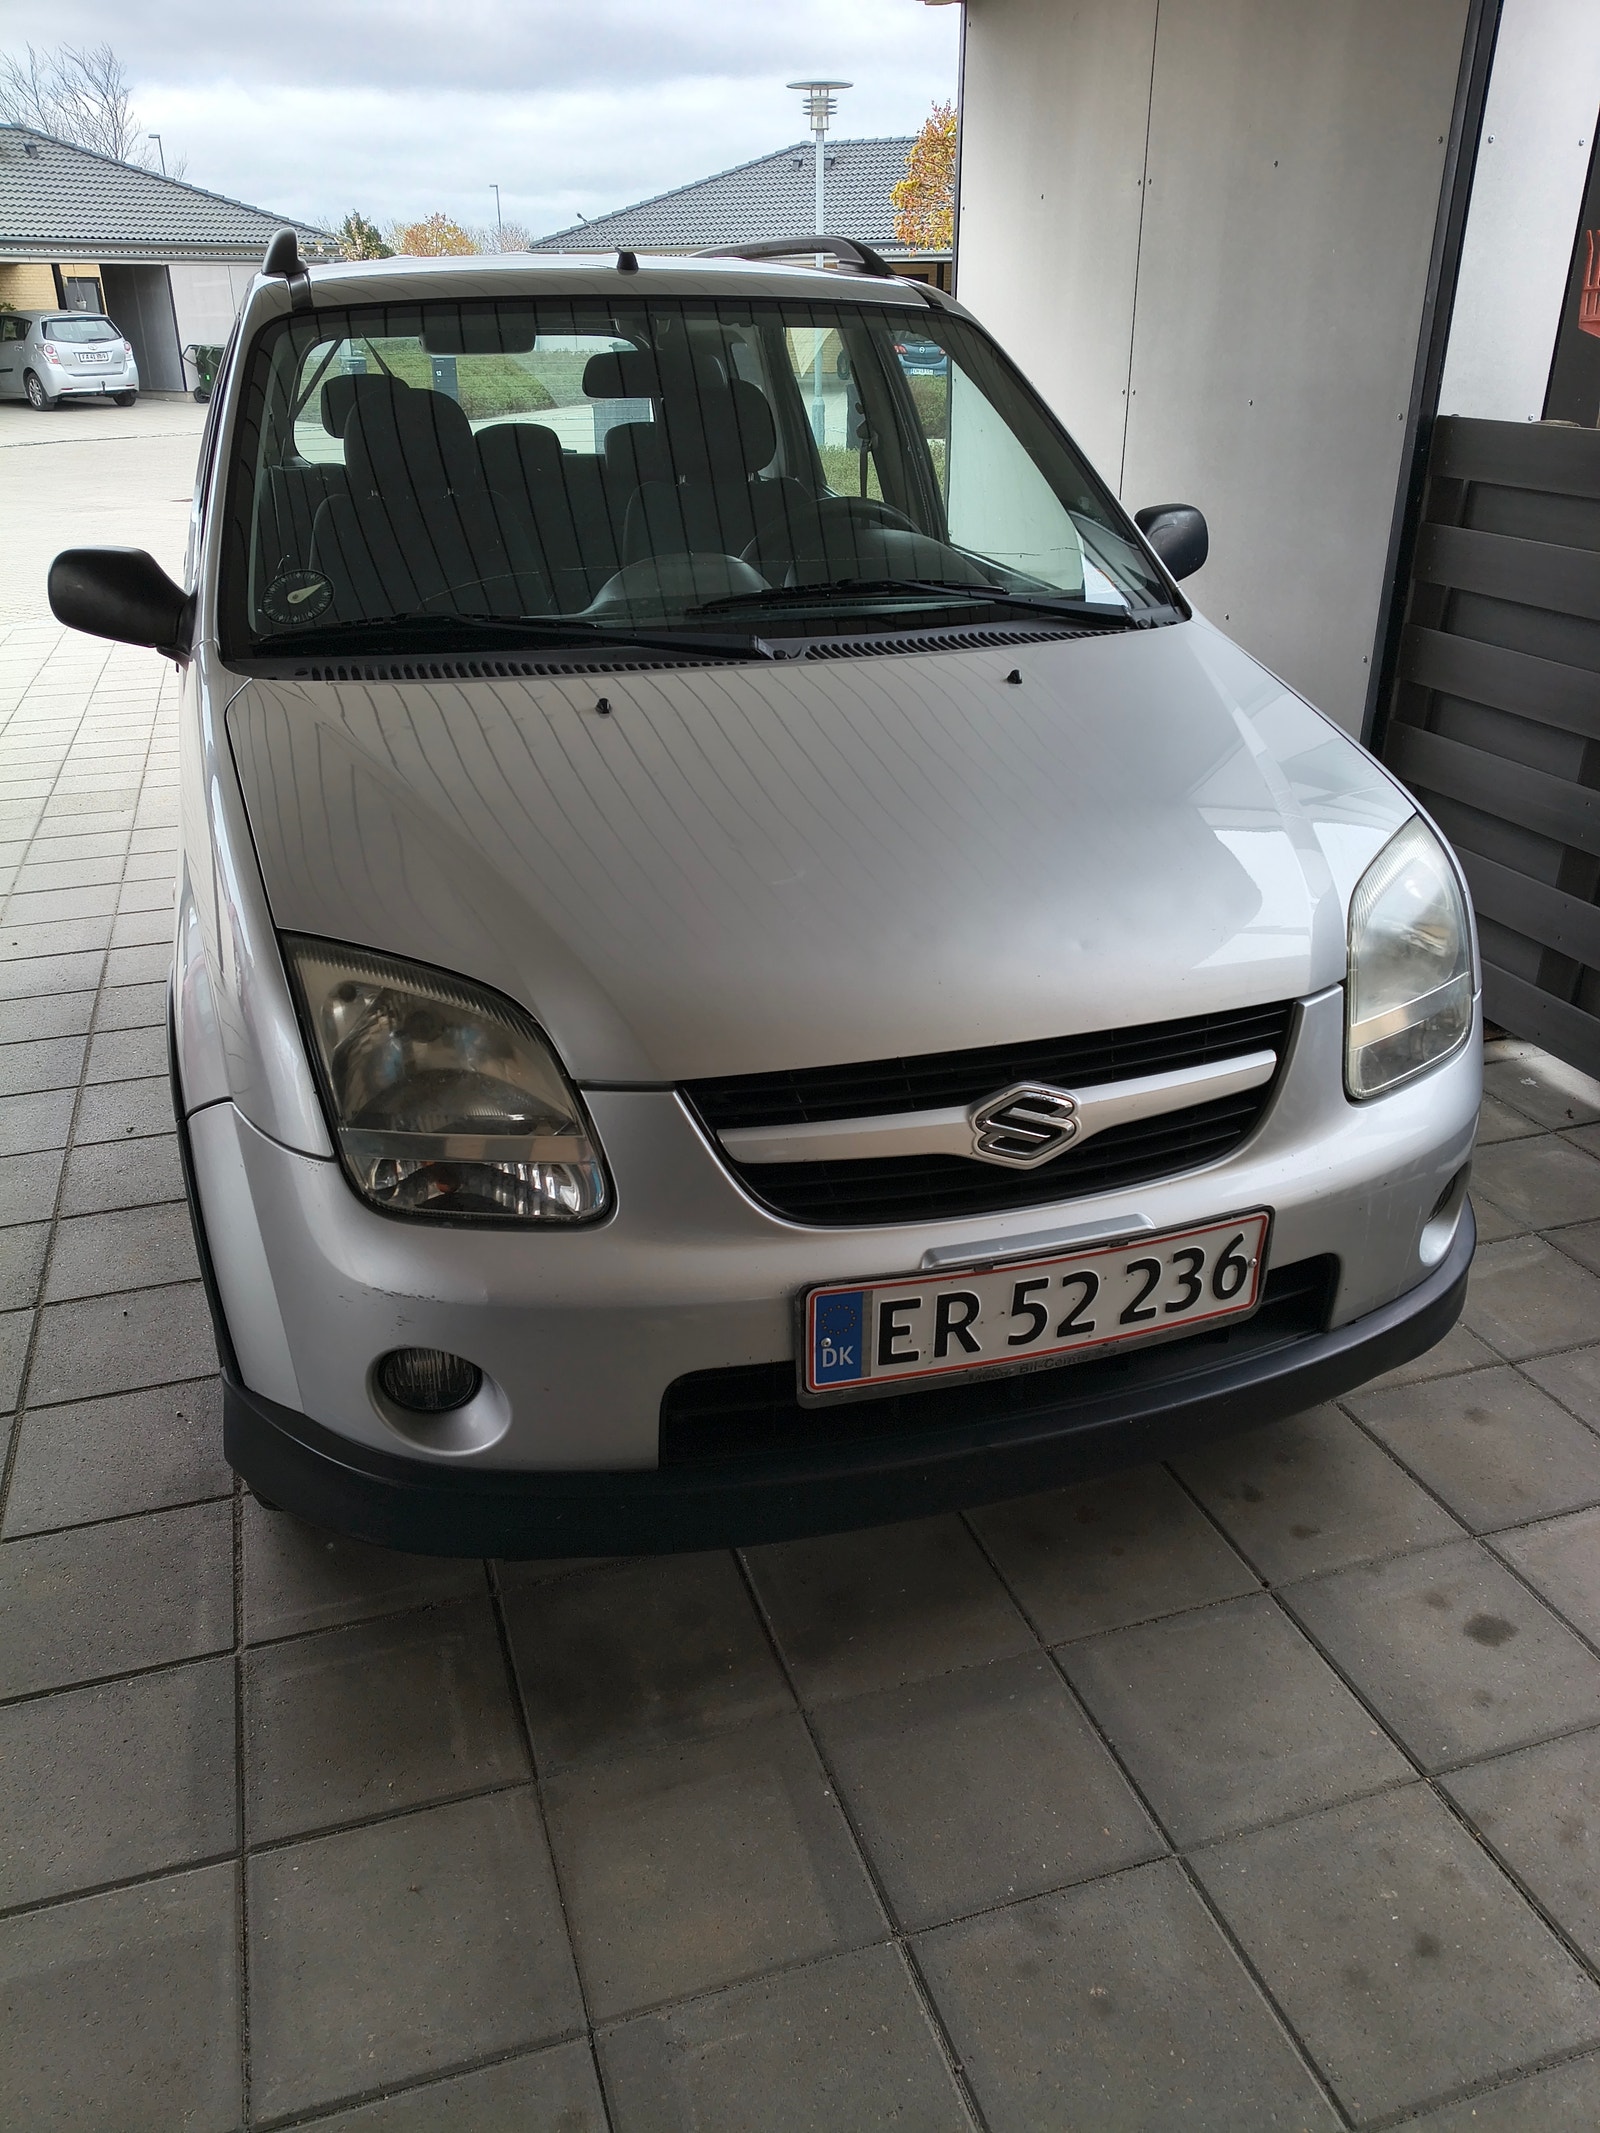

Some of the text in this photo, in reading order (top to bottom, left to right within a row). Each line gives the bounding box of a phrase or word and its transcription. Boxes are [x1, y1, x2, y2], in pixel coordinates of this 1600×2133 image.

[877, 1232, 1248, 1366] ER 52 236
[822, 1346, 854, 1367] DK
